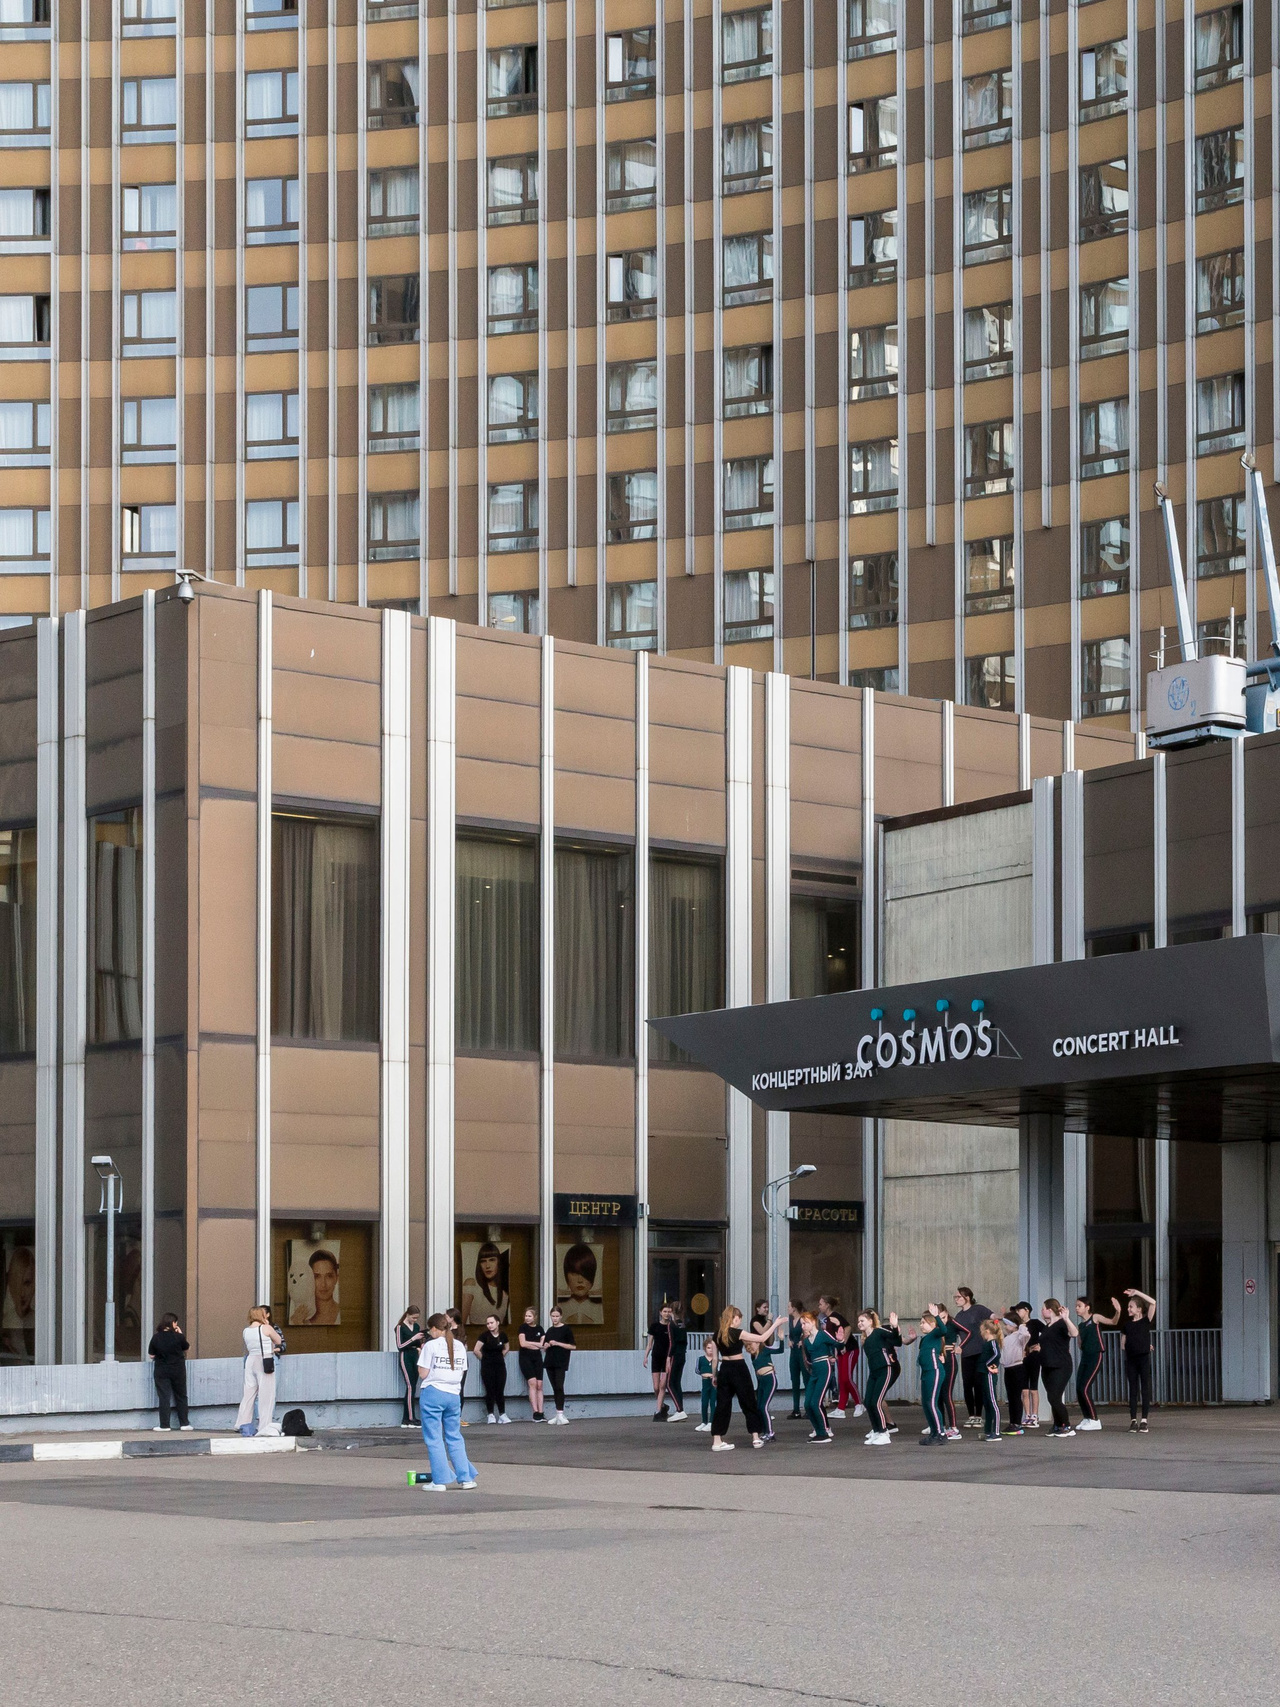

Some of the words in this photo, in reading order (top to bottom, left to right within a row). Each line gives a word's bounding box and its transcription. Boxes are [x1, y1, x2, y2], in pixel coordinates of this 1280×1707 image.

[857, 1019, 993, 1071] COSMOS
[1052, 1030, 1130, 1058] CONCERT
[1134, 1025, 1180, 1049] HALL
[752, 1062, 841, 1091] КОНЦЕРТНЫЙ
[569, 1201, 621, 1216] ЦЕНТР
